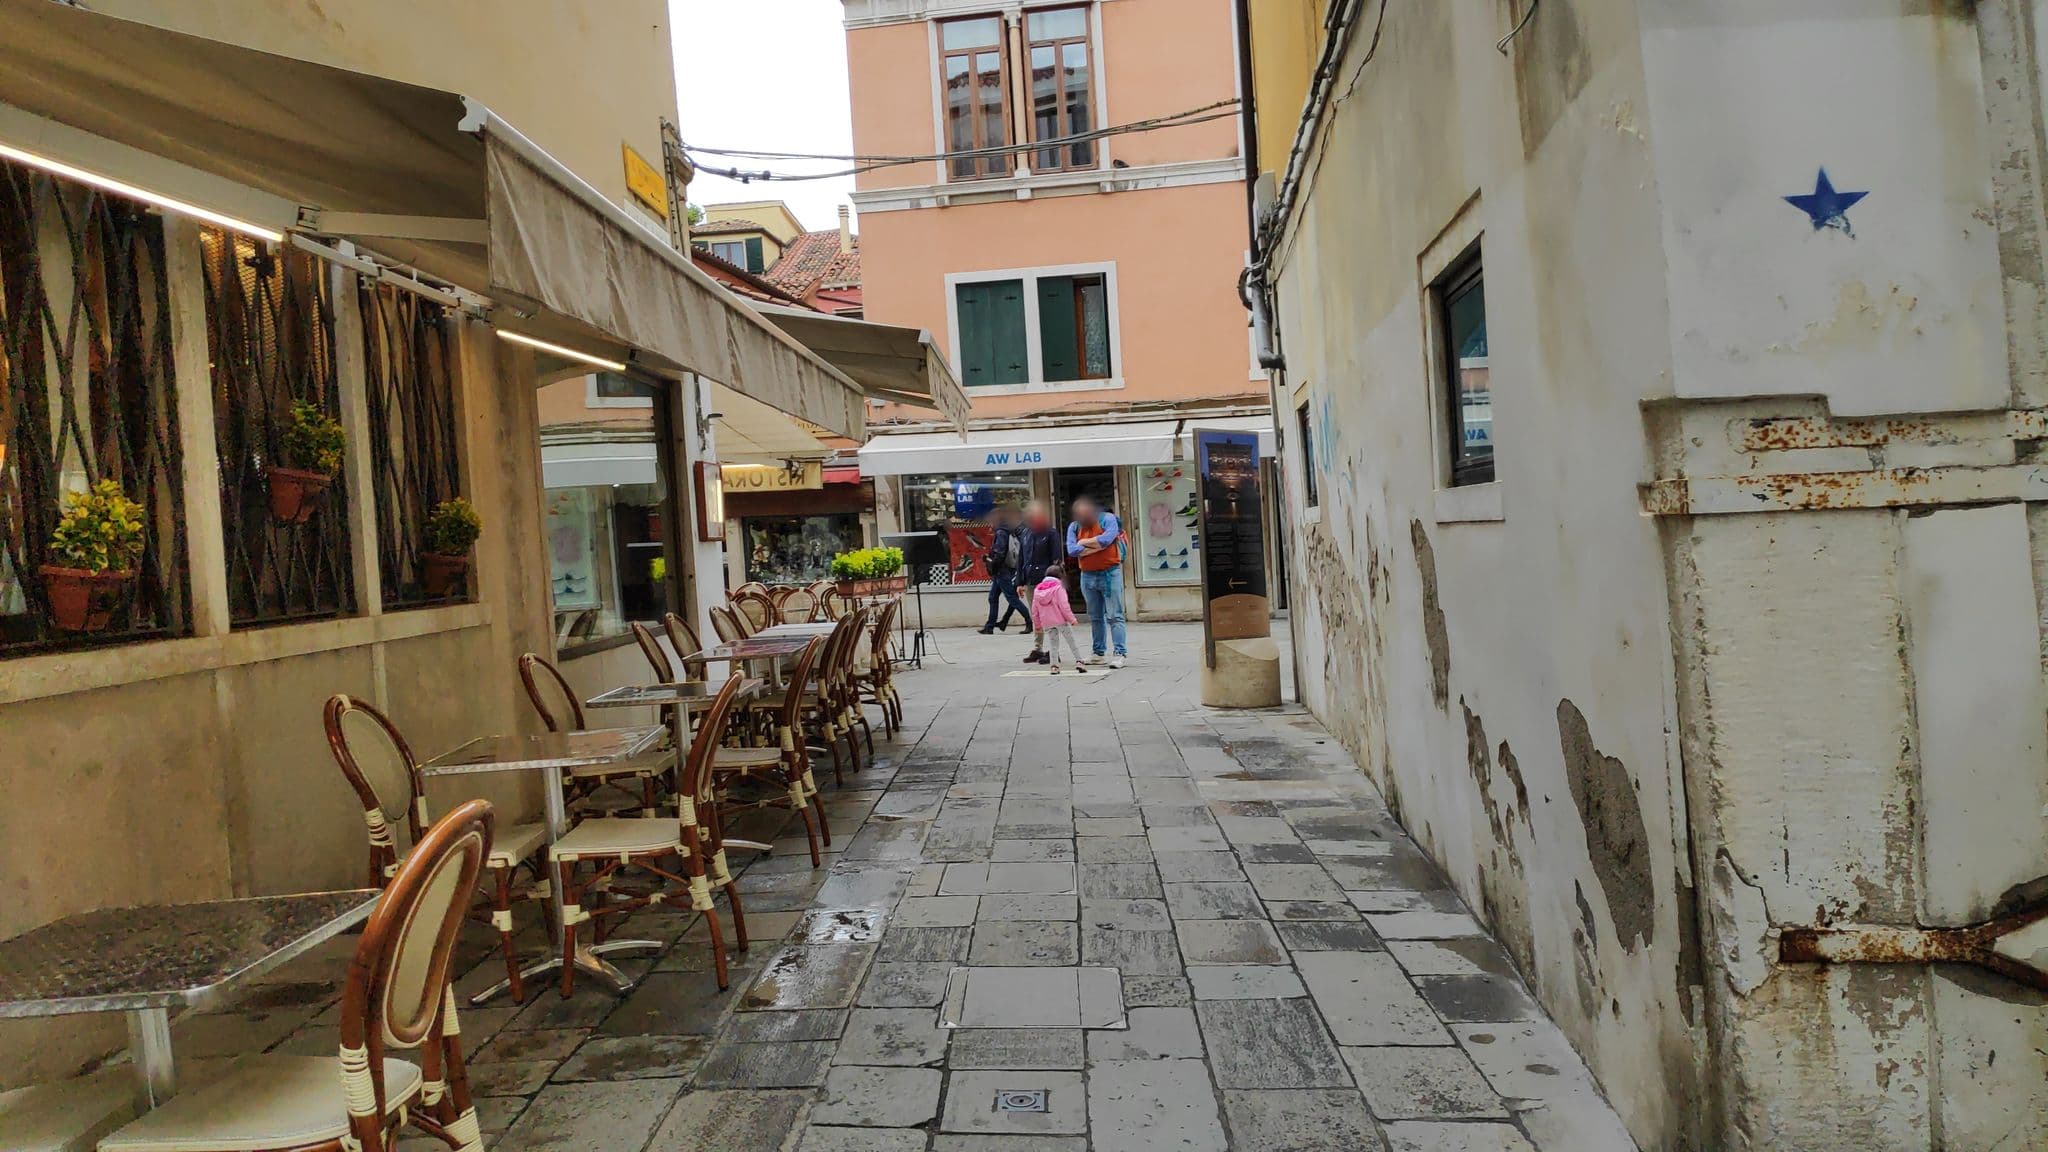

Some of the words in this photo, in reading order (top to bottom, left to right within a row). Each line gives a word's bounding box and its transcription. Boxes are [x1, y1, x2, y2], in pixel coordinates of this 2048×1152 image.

[986, 453, 1009, 464] AW
[1015, 452, 1041, 463] LAB
[958, 484, 979, 494] AW
